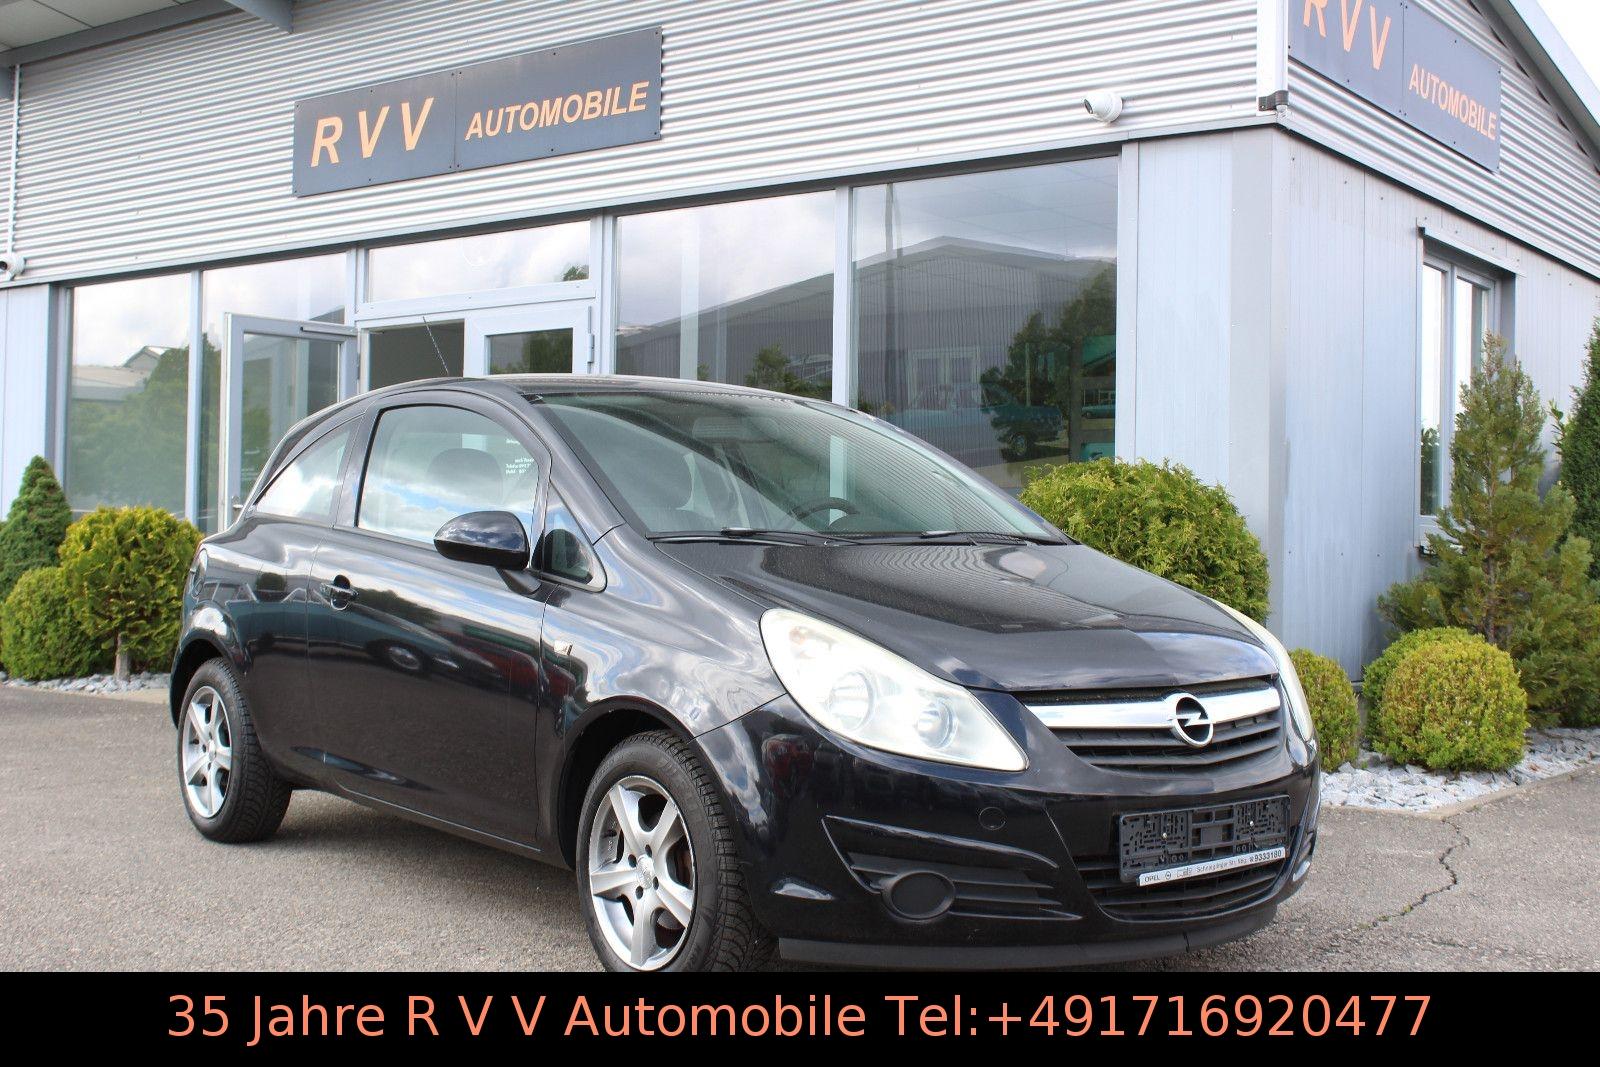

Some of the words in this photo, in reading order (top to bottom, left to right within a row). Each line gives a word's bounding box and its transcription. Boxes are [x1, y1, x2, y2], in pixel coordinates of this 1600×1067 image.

[464, 81, 650, 141] AUTOMOBILE
[1408, 64, 1497, 141] AUTOMOBILE
[1144, 874, 1161, 883] OPEL
[1254, 849, 1282, 863] 9333180
